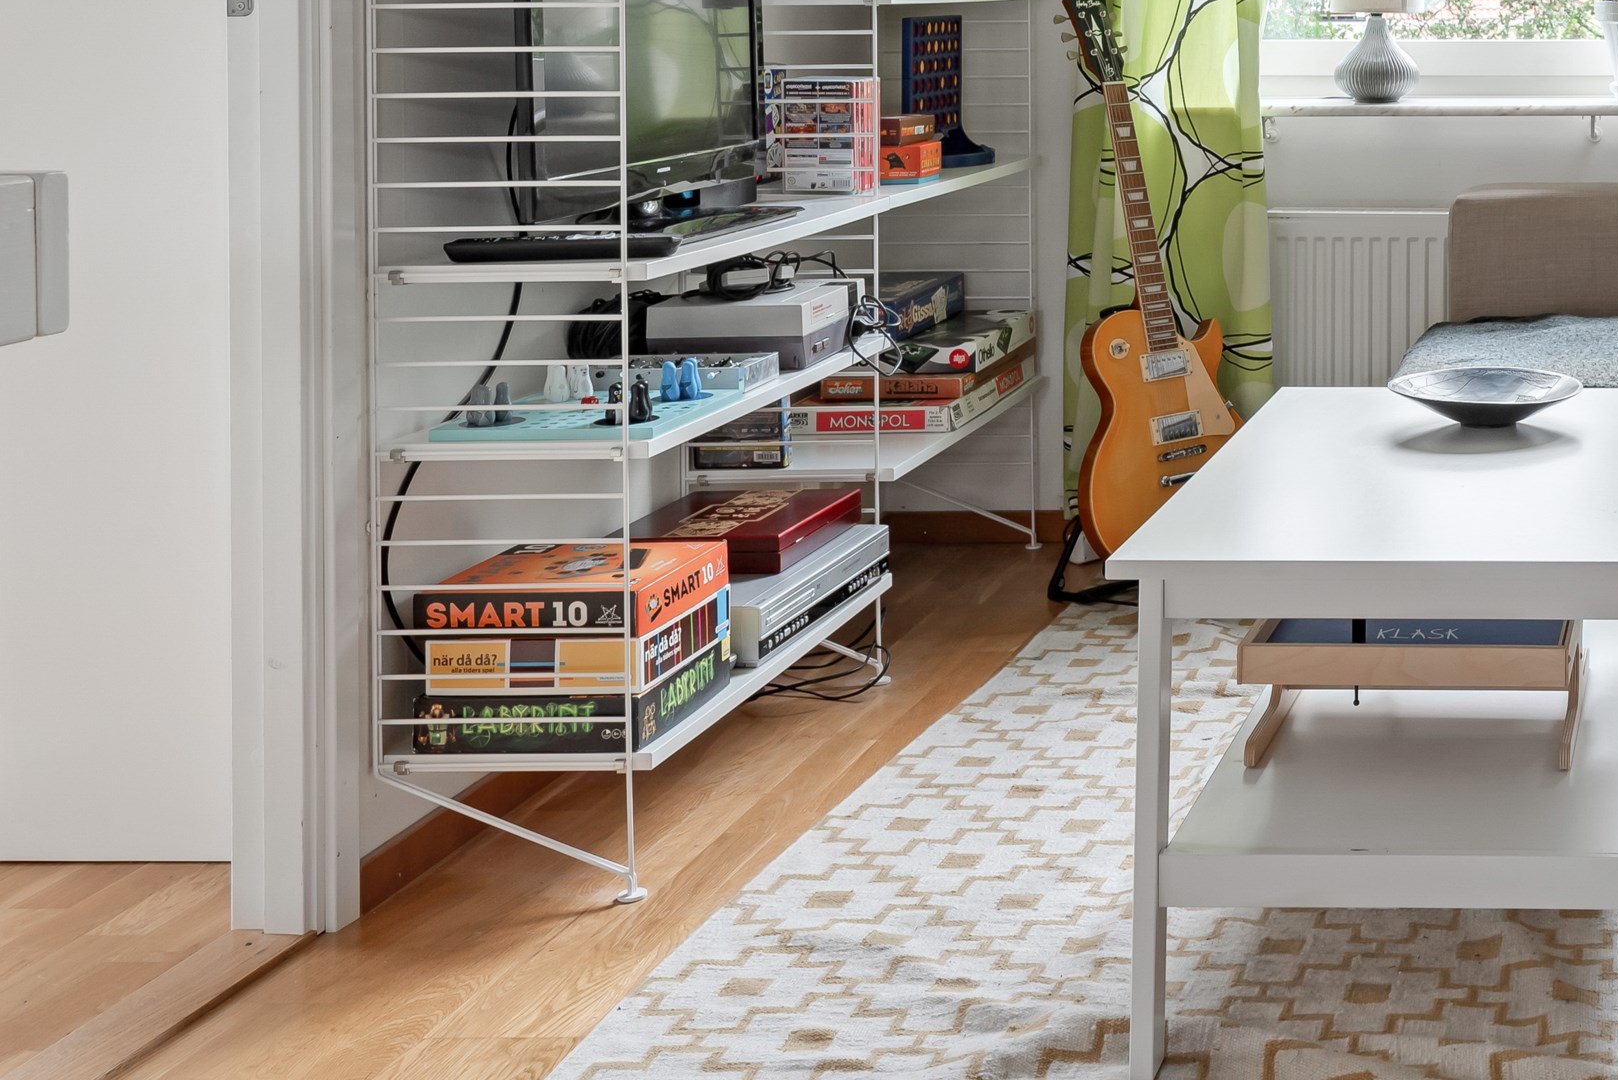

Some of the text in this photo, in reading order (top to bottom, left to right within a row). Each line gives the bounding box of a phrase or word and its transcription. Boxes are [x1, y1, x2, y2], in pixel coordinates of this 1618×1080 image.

[979, 343, 996, 365] Othello
[885, 378, 938, 395] Kalaha
[663, 562, 714, 608] SMART 10
[426, 600, 588, 629] SMART 10
[645, 627, 682, 662] när då då?
[1376, 627, 1460, 640] KLASK
[433, 654, 498, 666] när då då?
[660, 649, 715, 717] LABYRINT
[462, 702, 596, 735] LABYRINT
